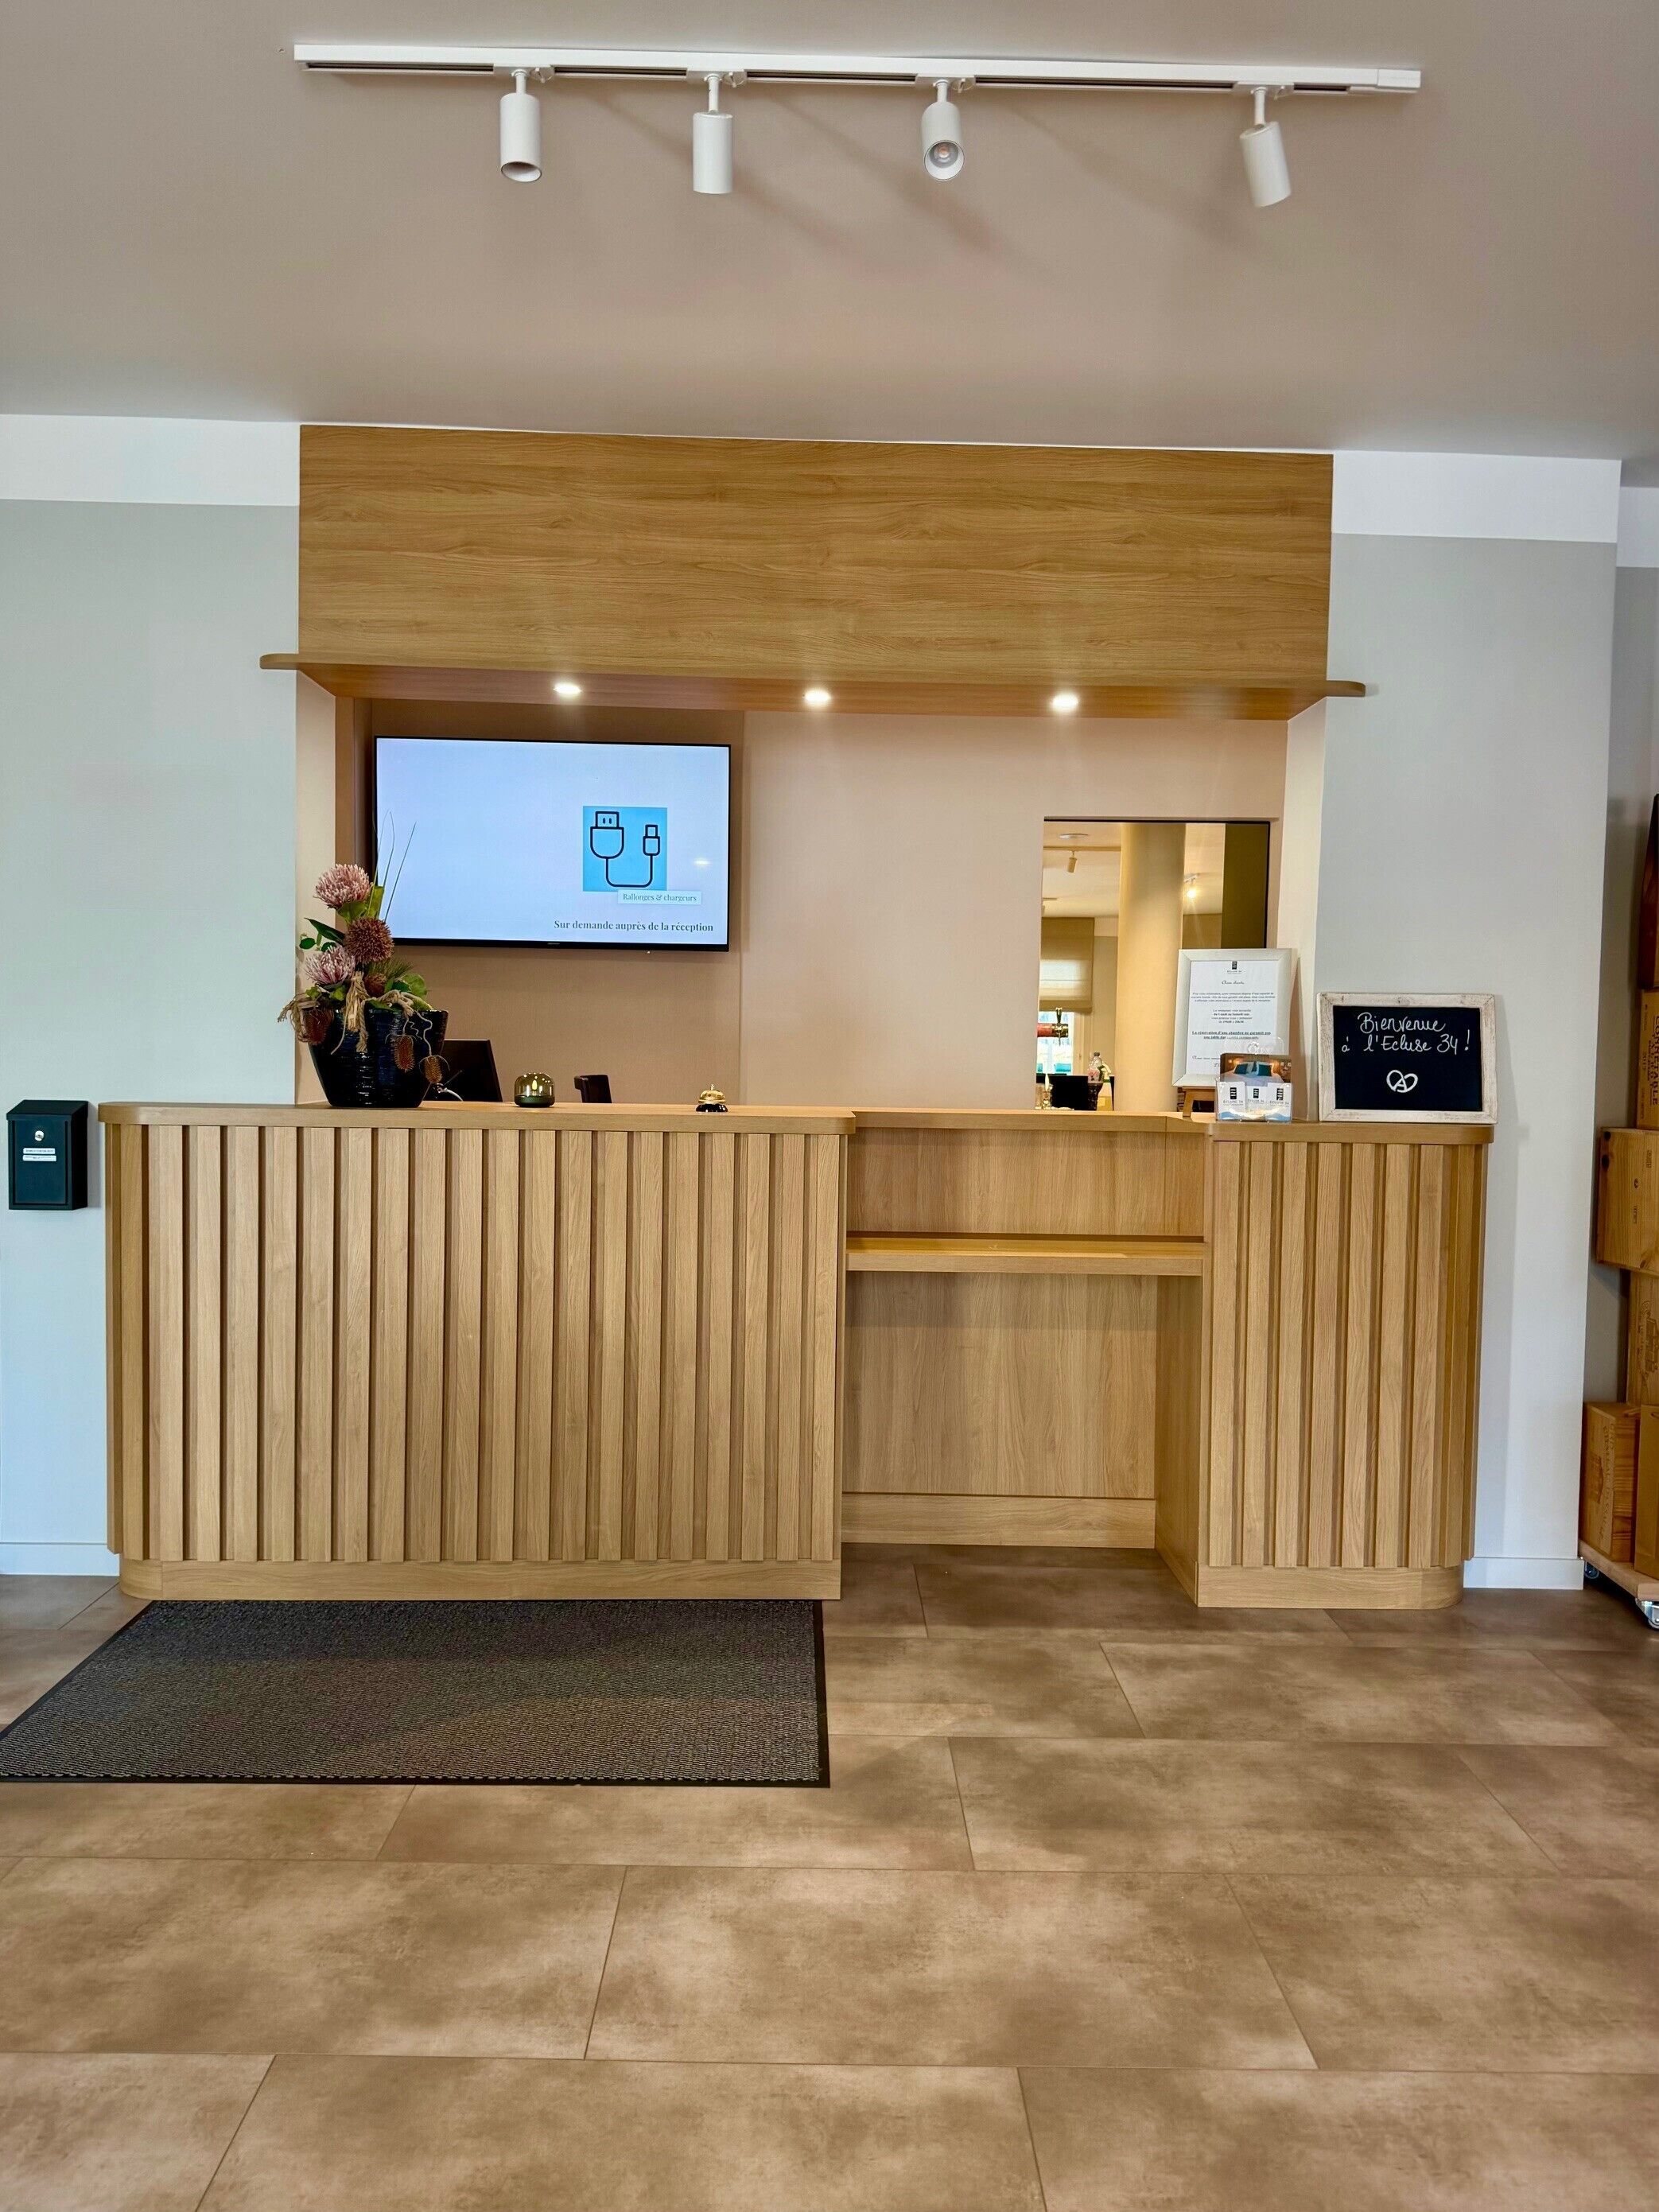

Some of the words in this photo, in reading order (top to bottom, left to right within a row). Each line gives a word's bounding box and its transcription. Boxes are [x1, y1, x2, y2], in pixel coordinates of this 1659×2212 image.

[623, 892, 655, 901] Rallonges
[663, 893, 697, 903] chargeurs
[554, 920, 570, 929] Sur
[572, 920, 613, 930] demande
[616, 921, 646, 931] auprès
[648, 922, 660, 931] de
[661, 922, 669, 931] la
[671, 921, 713, 932] réception
[1357, 1012, 1446, 1034] Bienvenue
[1363, 1034, 1432, 1052] l'Ecluse
[1437, 1034, 1458, 1055] 34
